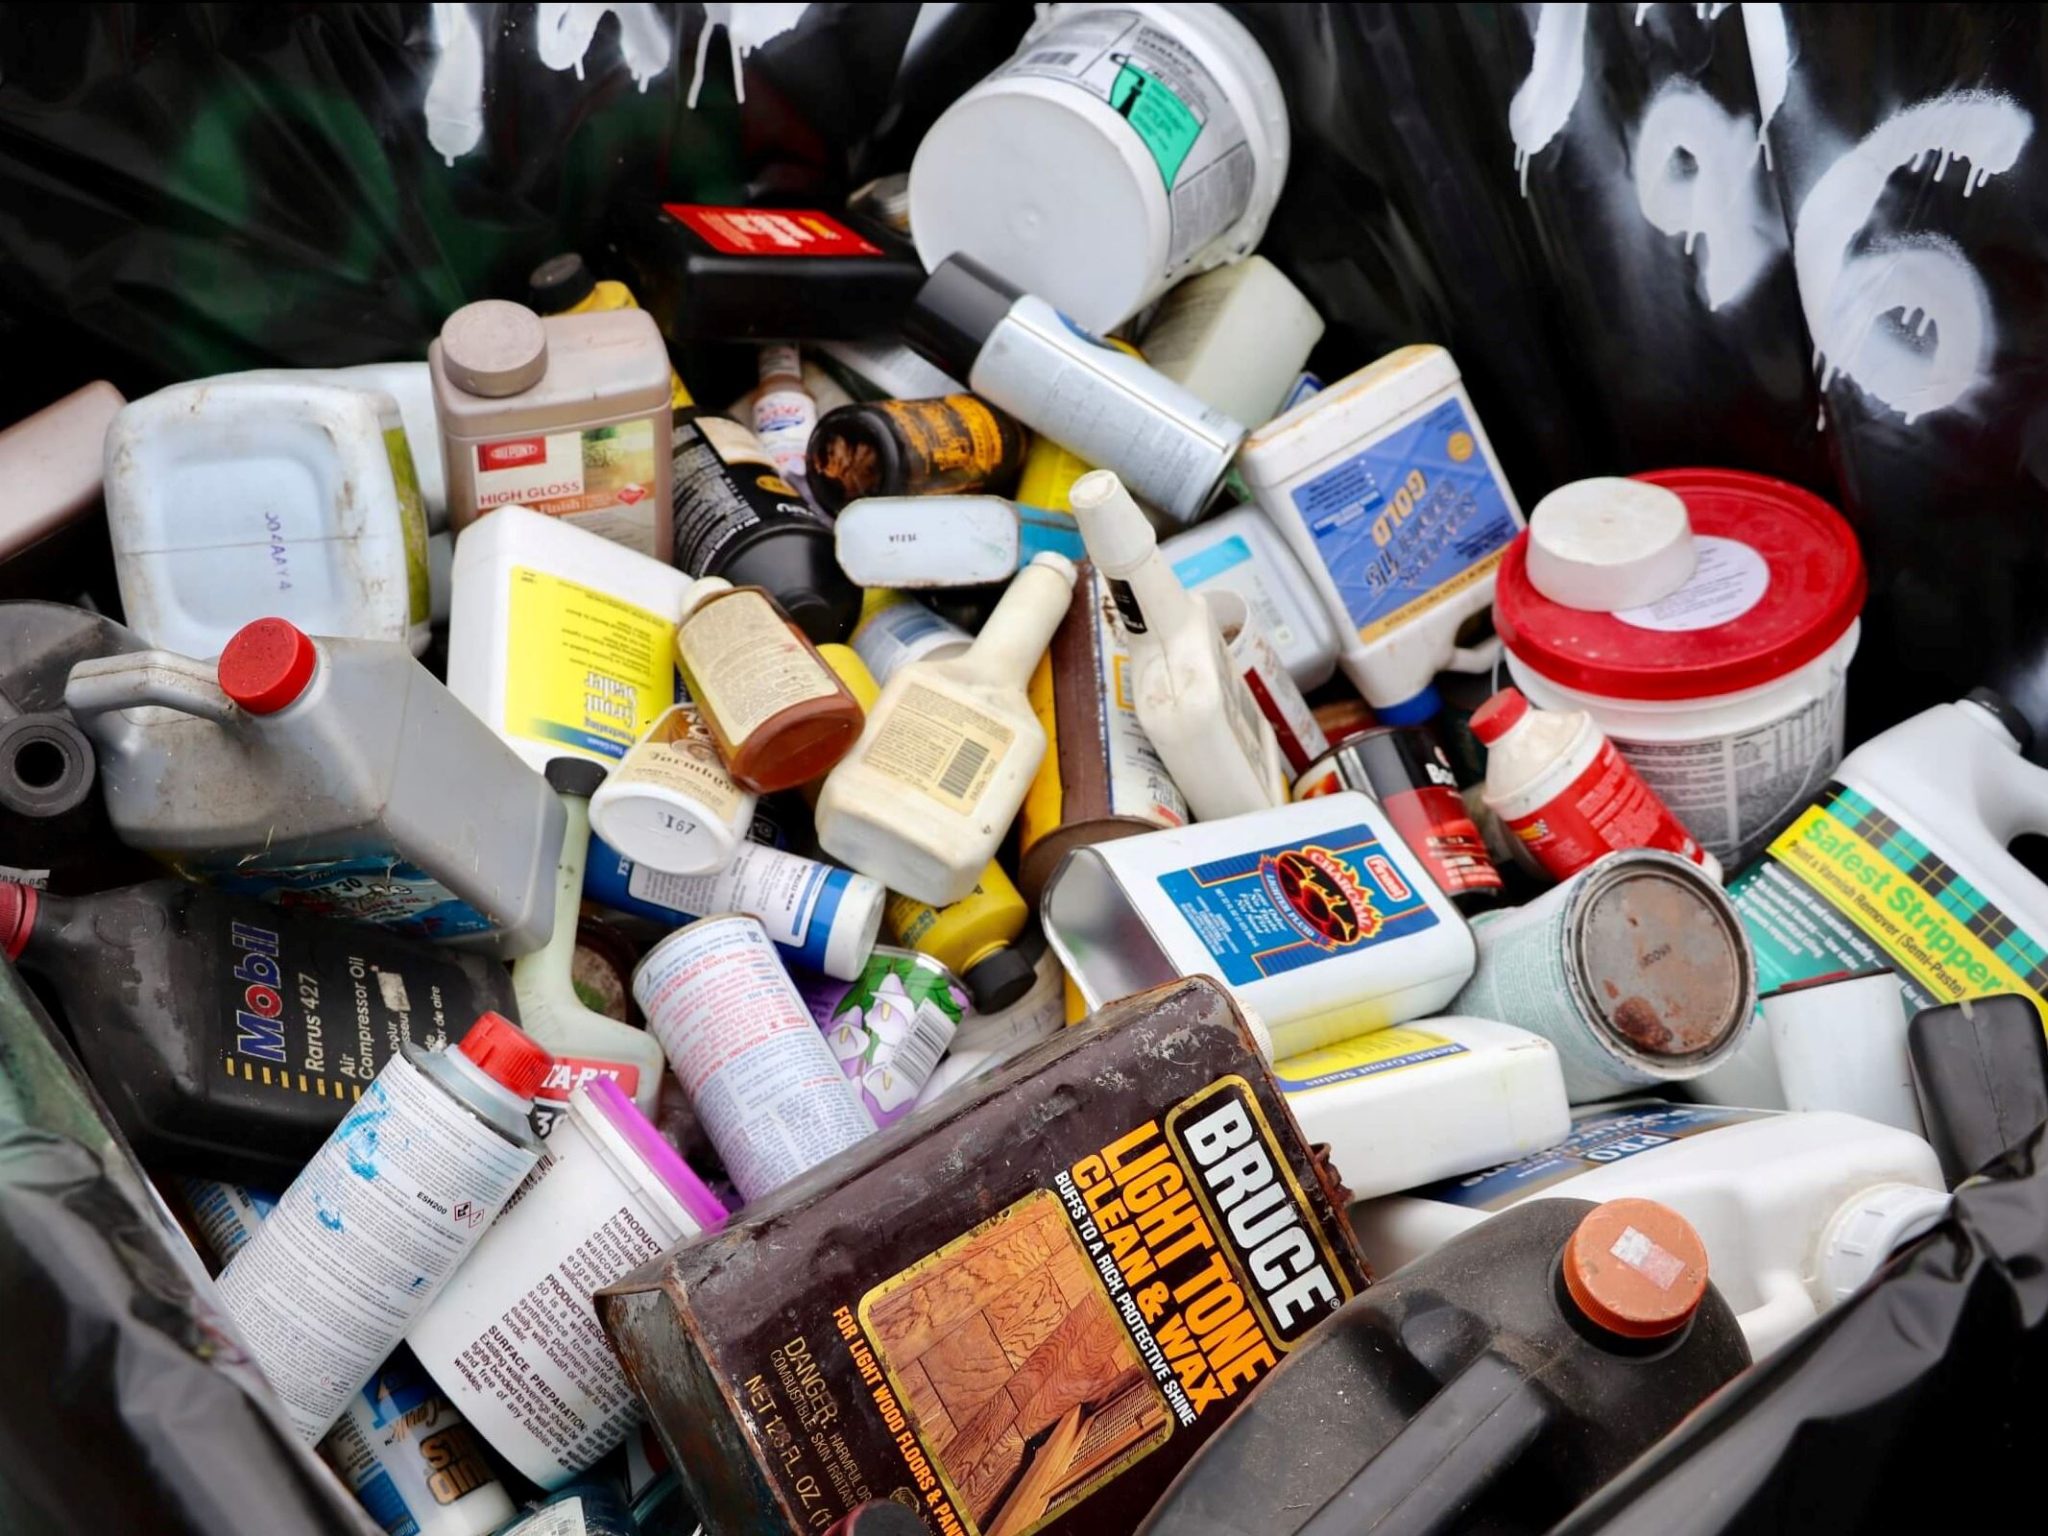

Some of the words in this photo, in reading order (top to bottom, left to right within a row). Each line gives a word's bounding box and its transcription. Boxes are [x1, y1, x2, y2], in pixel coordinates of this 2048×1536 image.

[480, 489, 522, 506] HIGH
[527, 482, 580, 499] GLOSS
[1372, 469, 1427, 546] GOLD
[586, 693, 638, 728] Grout
[1311, 851, 1372, 929] CHARCOAL
[1803, 817, 1894, 892] Safest
[1886, 886, 2002, 996] Stripper
[1816, 860, 1858, 901] Varnish
[1854, 890, 1899, 937] Remover
[1897, 928, 1968, 997] (Semi-Paste)
[231, 920, 287, 1063] Mobil
[298, 972, 320, 1010] 427
[348, 956, 366, 980] Oil
[304, 1014, 325, 1073] Rarus
[352, 983, 375, 1081] Compressor
[340, 1053, 357, 1079] Air
[1305, 1068, 1358, 1087] Stains
[1357, 1058, 1407, 1076] Grout
[1584, 1132, 1669, 1163] PRO
[416, 1190, 448, 1216] ESH200
[1054, 1170, 1087, 1221] BUFFS
[1183, 1099, 1337, 1330] BRUCE
[593, 1231, 625, 1268] directly
[601, 1223, 643, 1268] formulated
[609, 1215, 651, 1264] heavy-duty
[617, 1206, 664, 1256] PRODUCT
[1079, 1216, 1099, 1241] TO
[1088, 1239, 1102, 1253] A
[566, 1254, 597, 1289] edges
[575, 1247, 611, 1287] excellent
[584, 1239, 621, 1282] wallcove
[1096, 1253, 1123, 1296] RICH,
[1100, 1119, 1215, 1269] LIGHT
[1172, 1252, 1277, 1397] TONE
[544, 1273, 586, 1319] PRODUCT
[559, 1262, 594, 1306] wallcover
[1071, 1154, 1157, 1286] CLEAN
[1136, 1281, 1169, 1324] &
[1155, 1313, 1225, 1416] WAX
[501, 1313, 526, 1345] border.
[519, 1298, 554, 1338] synthetic
[551, 1337, 588, 1378] polymers.
[527, 1290, 570, 1338] substance
[570, 1338, 613, 1384] formulated
[536, 1281, 550, 1297] 50
[549, 1298, 560, 1309] is
[569, 1320, 592, 1347] white
[1116, 1292, 1171, 1382] PROTECTIVE
[510, 1306, 532, 1332] easily
[531, 1330, 549, 1350] with
[546, 1348, 569, 1376] brush
[453, 1357, 483, 1395] wrinkles.
[462, 1349, 480, 1370] and
[477, 1367, 497, 1390] free
[495, 1388, 508, 1402] of
[506, 1401, 524, 1420] any
[523, 1418, 552, 1449] bubbles
[470, 1341, 493, 1368] tightly
[489, 1363, 518, 1397] bonded
[522, 1400, 536, 1416] the
[533, 1412, 550, 1430] wall
[479, 1332, 508, 1368] Existing
[505, 1364, 551, 1416] wallcoverings
[548, 1411, 572, 1435] should
[488, 1324, 531, 1374] SURFACE
[529, 1373, 588, 1432] PREPARATION:
[784, 1336, 838, 1430] DANGER:
[828, 1431, 860, 1488] HARMFUL
[832, 1304, 859, 1341] FOR
[848, 1338, 884, 1387] LIGHT
[872, 1376, 906, 1434] WOOD
[896, 1430, 936, 1492] FLOORS
[926, 1488, 944, 1505] &
[1163, 1379, 1197, 1428] SHINE
[744, 1373, 778, 1415] NET
[795, 1475, 822, 1510] OZ.
[810, 1432, 833, 1463] SKIN
